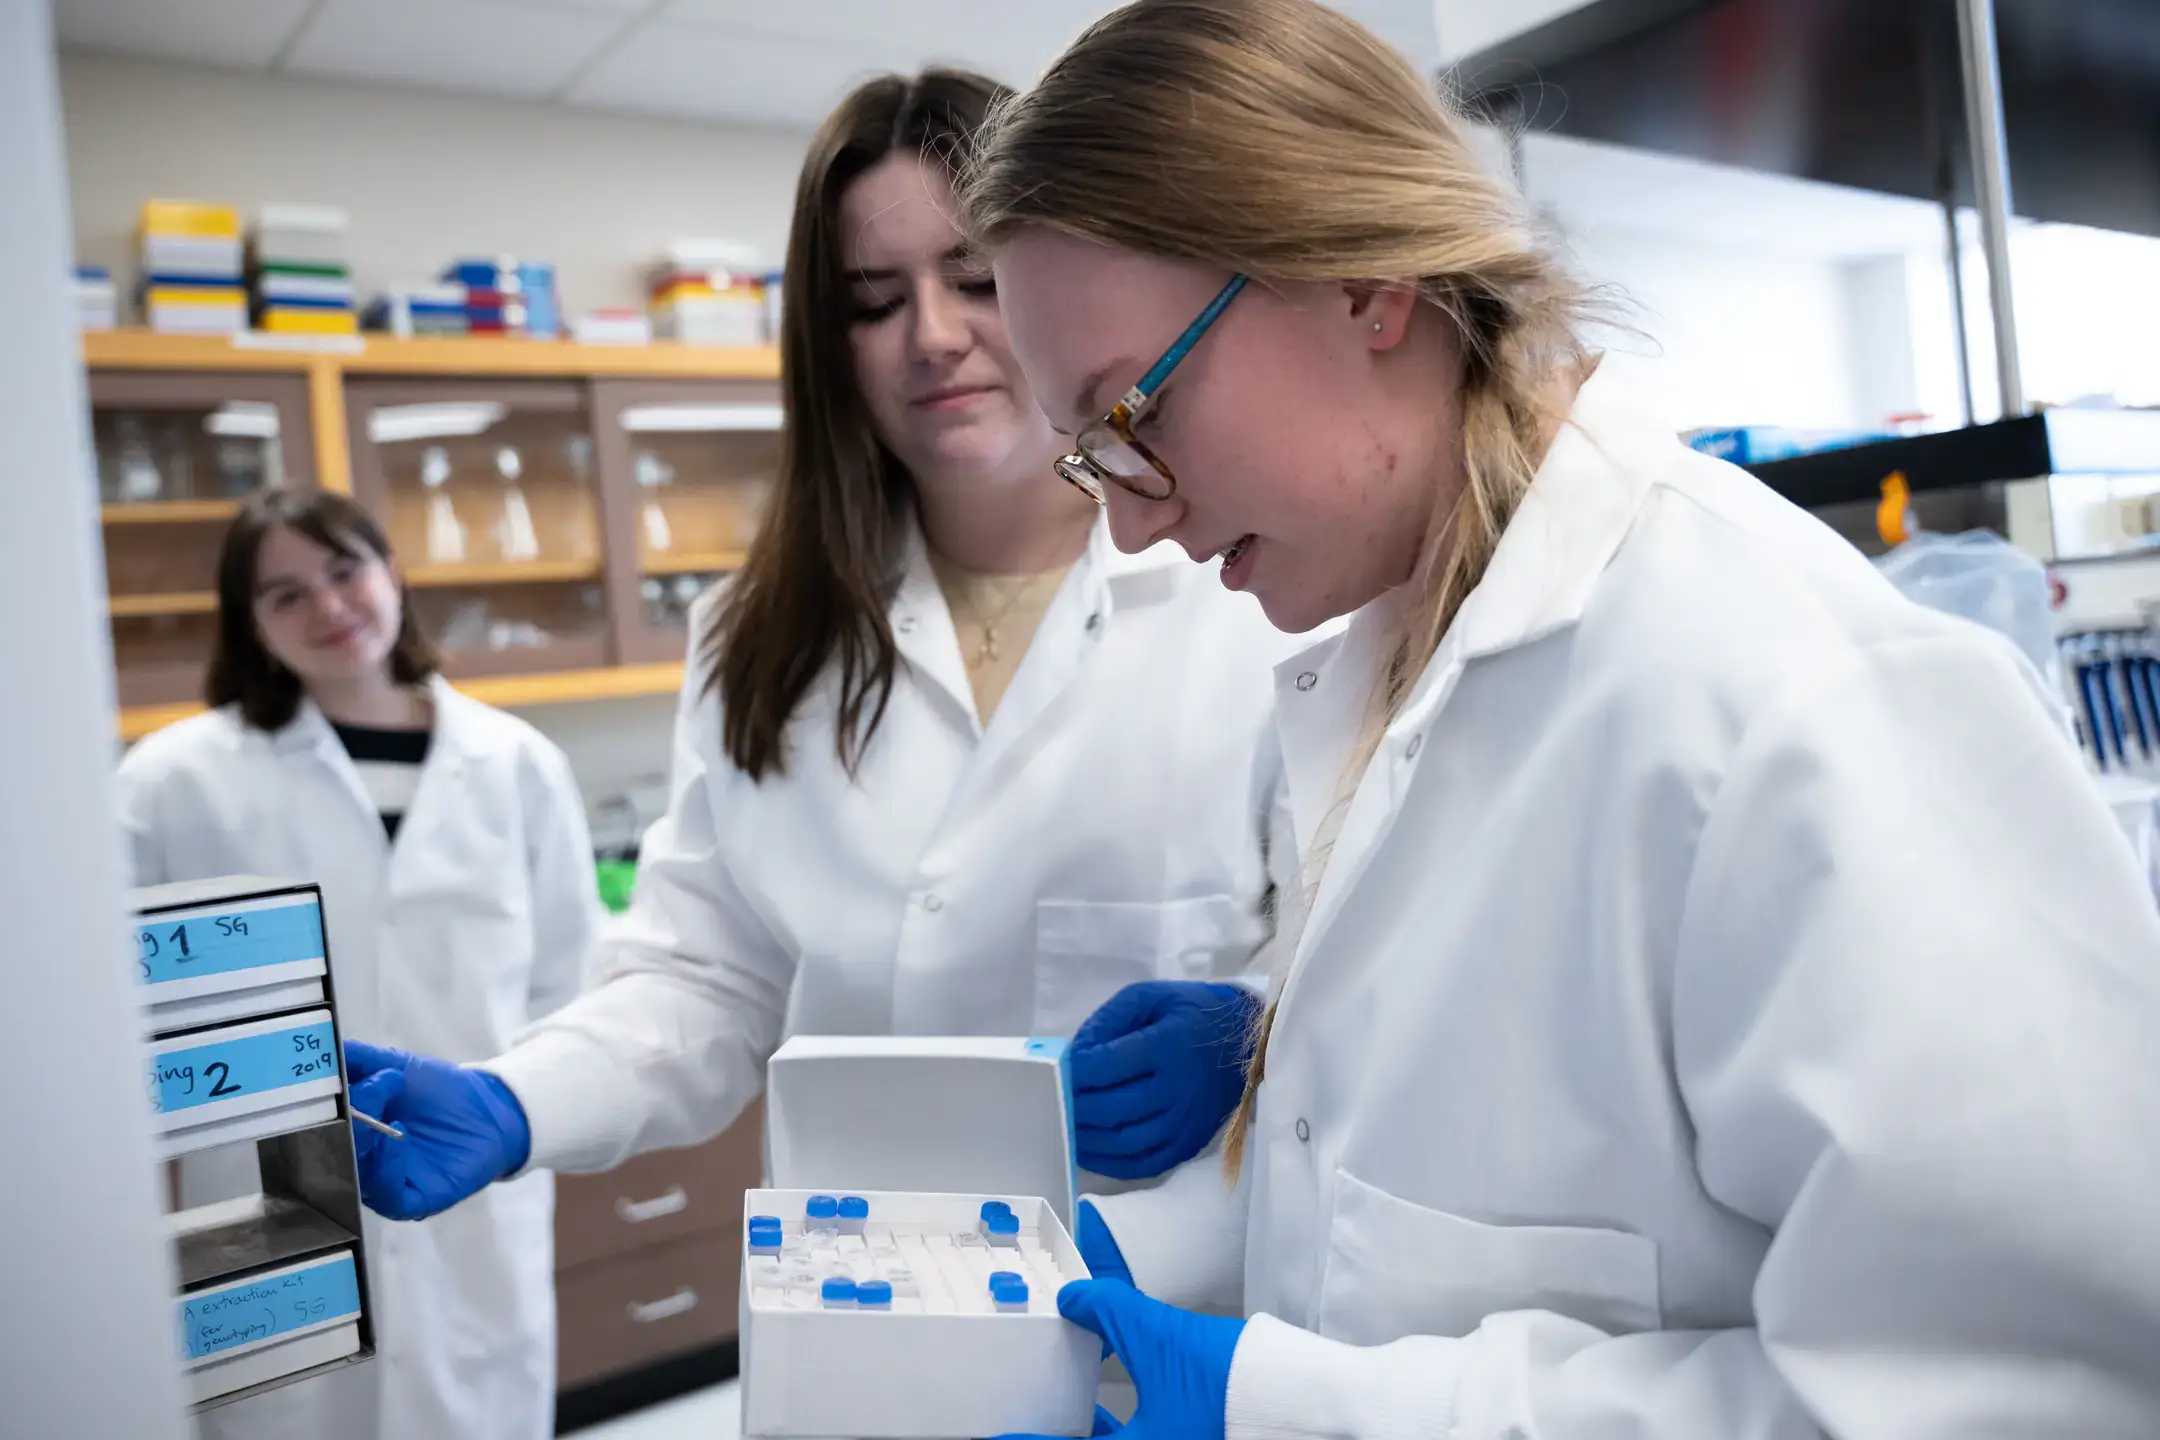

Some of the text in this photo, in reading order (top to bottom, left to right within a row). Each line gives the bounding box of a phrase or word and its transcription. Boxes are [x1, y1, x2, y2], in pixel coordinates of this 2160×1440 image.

[215, 916, 249, 937] SG
[169, 924, 190, 957] 1
[292, 1034, 321, 1052] SG
[292, 1052, 332, 1077] 2019
[203, 1061, 242, 1098] 2
[202, 1286, 278, 1315] extraction
